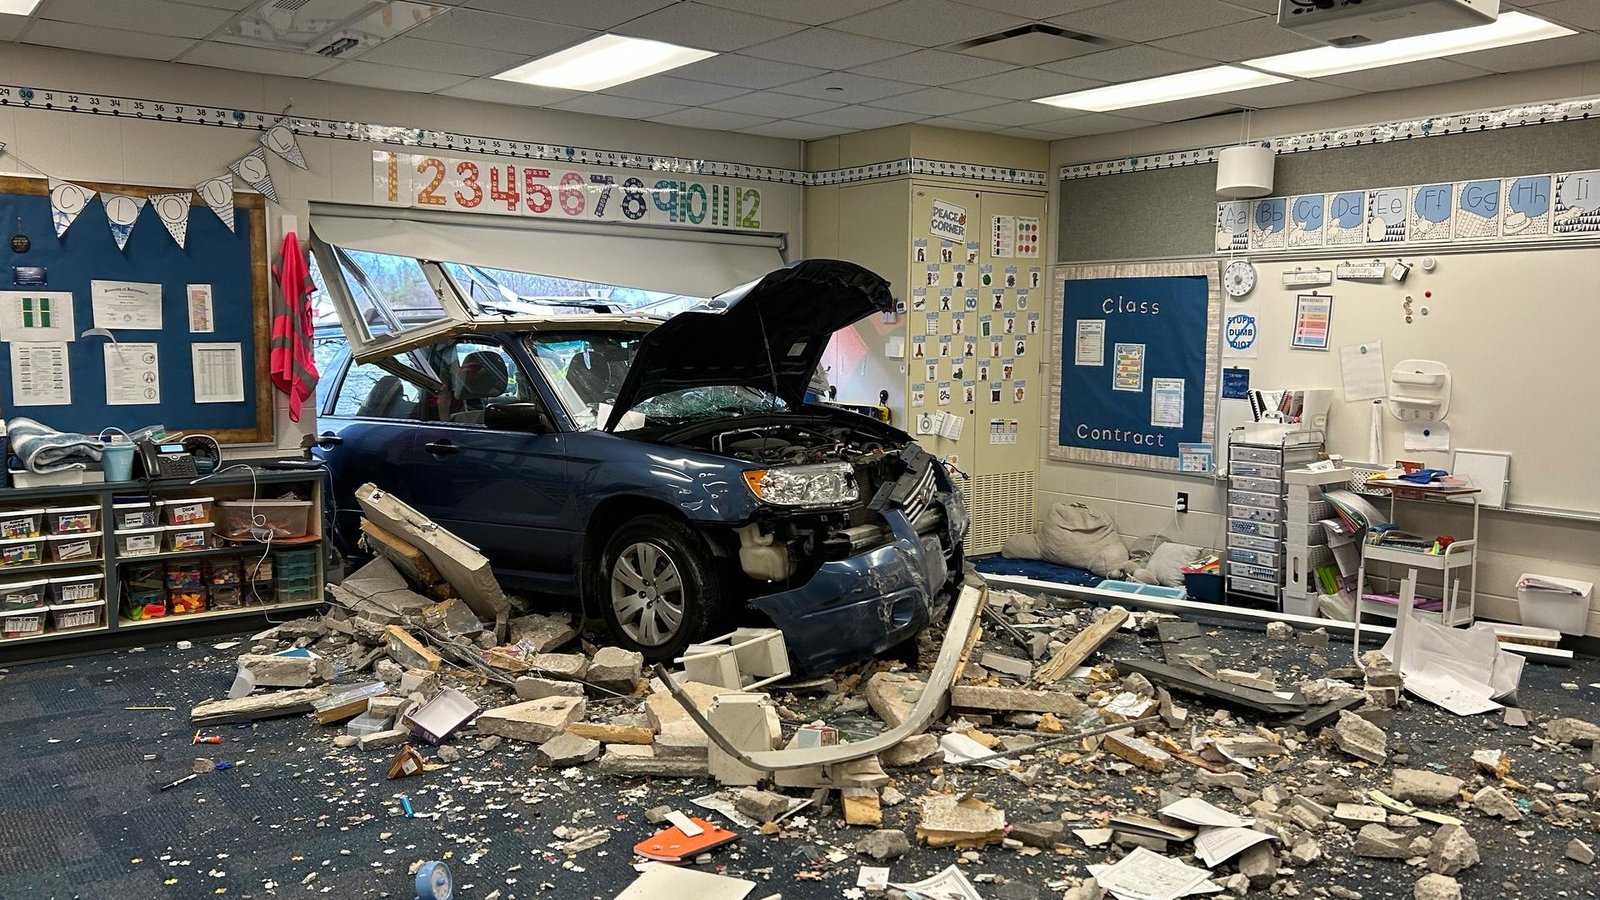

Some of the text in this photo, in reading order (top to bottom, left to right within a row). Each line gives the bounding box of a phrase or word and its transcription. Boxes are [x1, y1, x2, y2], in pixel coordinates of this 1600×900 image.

[68, 95, 79, 103] 32
[155, 104, 165, 112] 36
[328, 123, 338, 131] 45
[388, 154, 760, 229] 1 2 3 4 5 6 7 8 9 10 11 12
[1225, 178, 1589, 225] Aa Bb Cc Dd Ee Ff Gg Hh Ii
[933, 207, 959, 222] PEACE
[931, 219, 965, 236] CORNER
[1102, 295, 1160, 315] Class
[1227, 316, 1256, 324] STUPID
[1077, 424, 1165, 448] Contract
